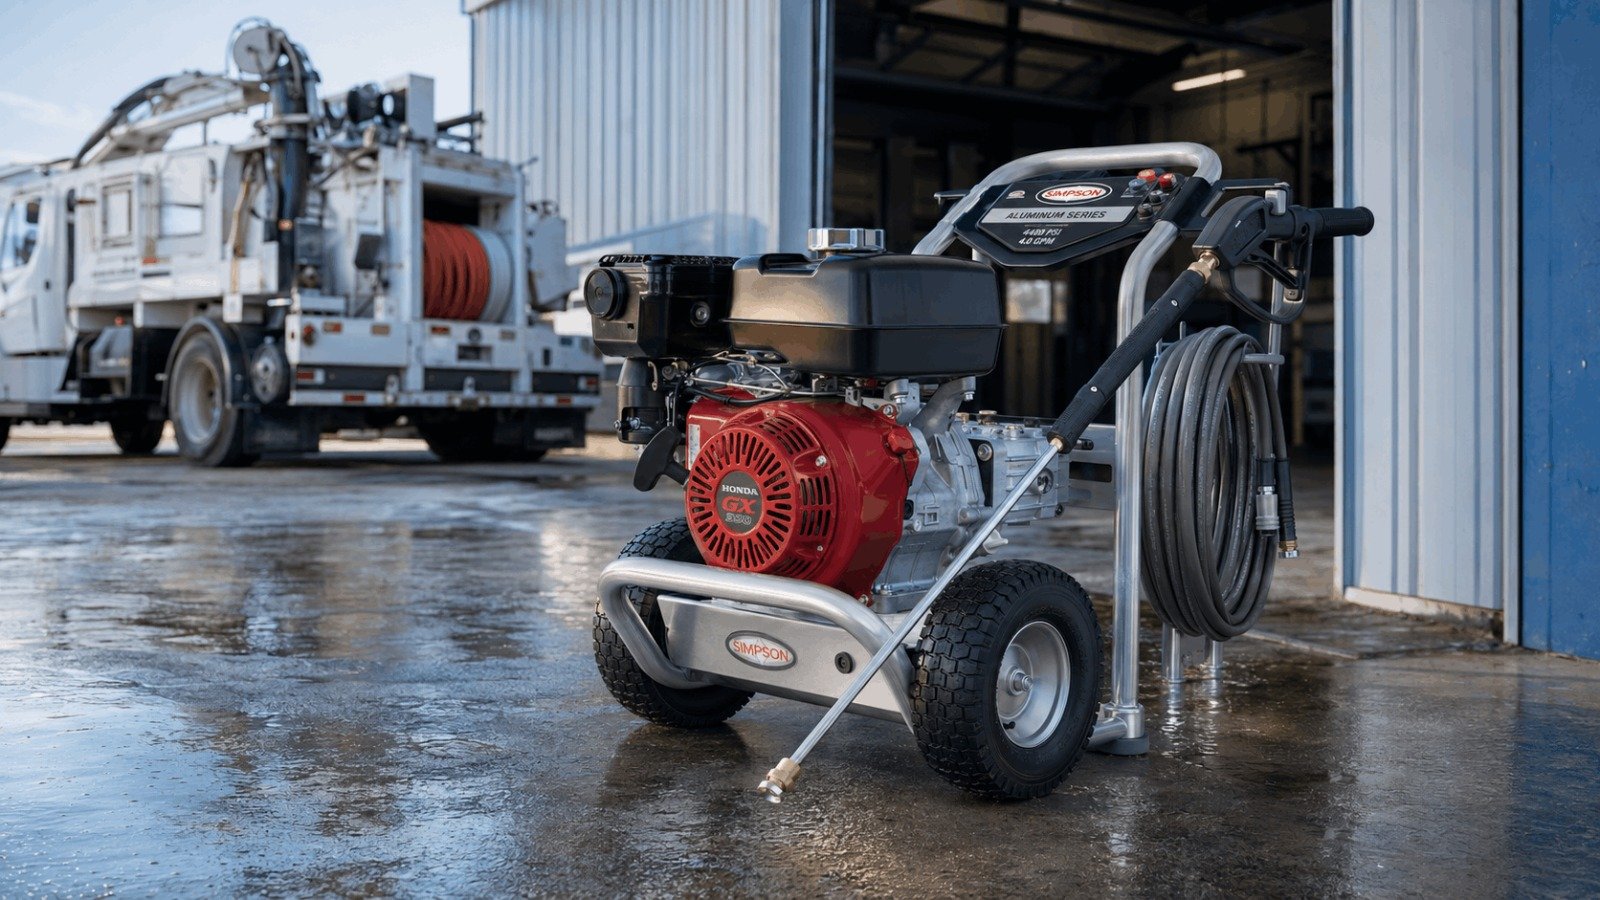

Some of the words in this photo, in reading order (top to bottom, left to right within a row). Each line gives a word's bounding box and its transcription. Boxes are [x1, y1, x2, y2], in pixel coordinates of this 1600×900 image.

[1045, 189, 1102, 198] SIMPSON
[1005, 211, 1065, 219] ALUMINUM
[1066, 210, 1107, 219] SERIES
[1018, 237, 1033, 245] 4.0
[1033, 237, 1056, 245] GPM
[722, 484, 758, 496] HONDA
[722, 496, 756, 515] GX
[733, 640, 788, 661] SIMPSON
